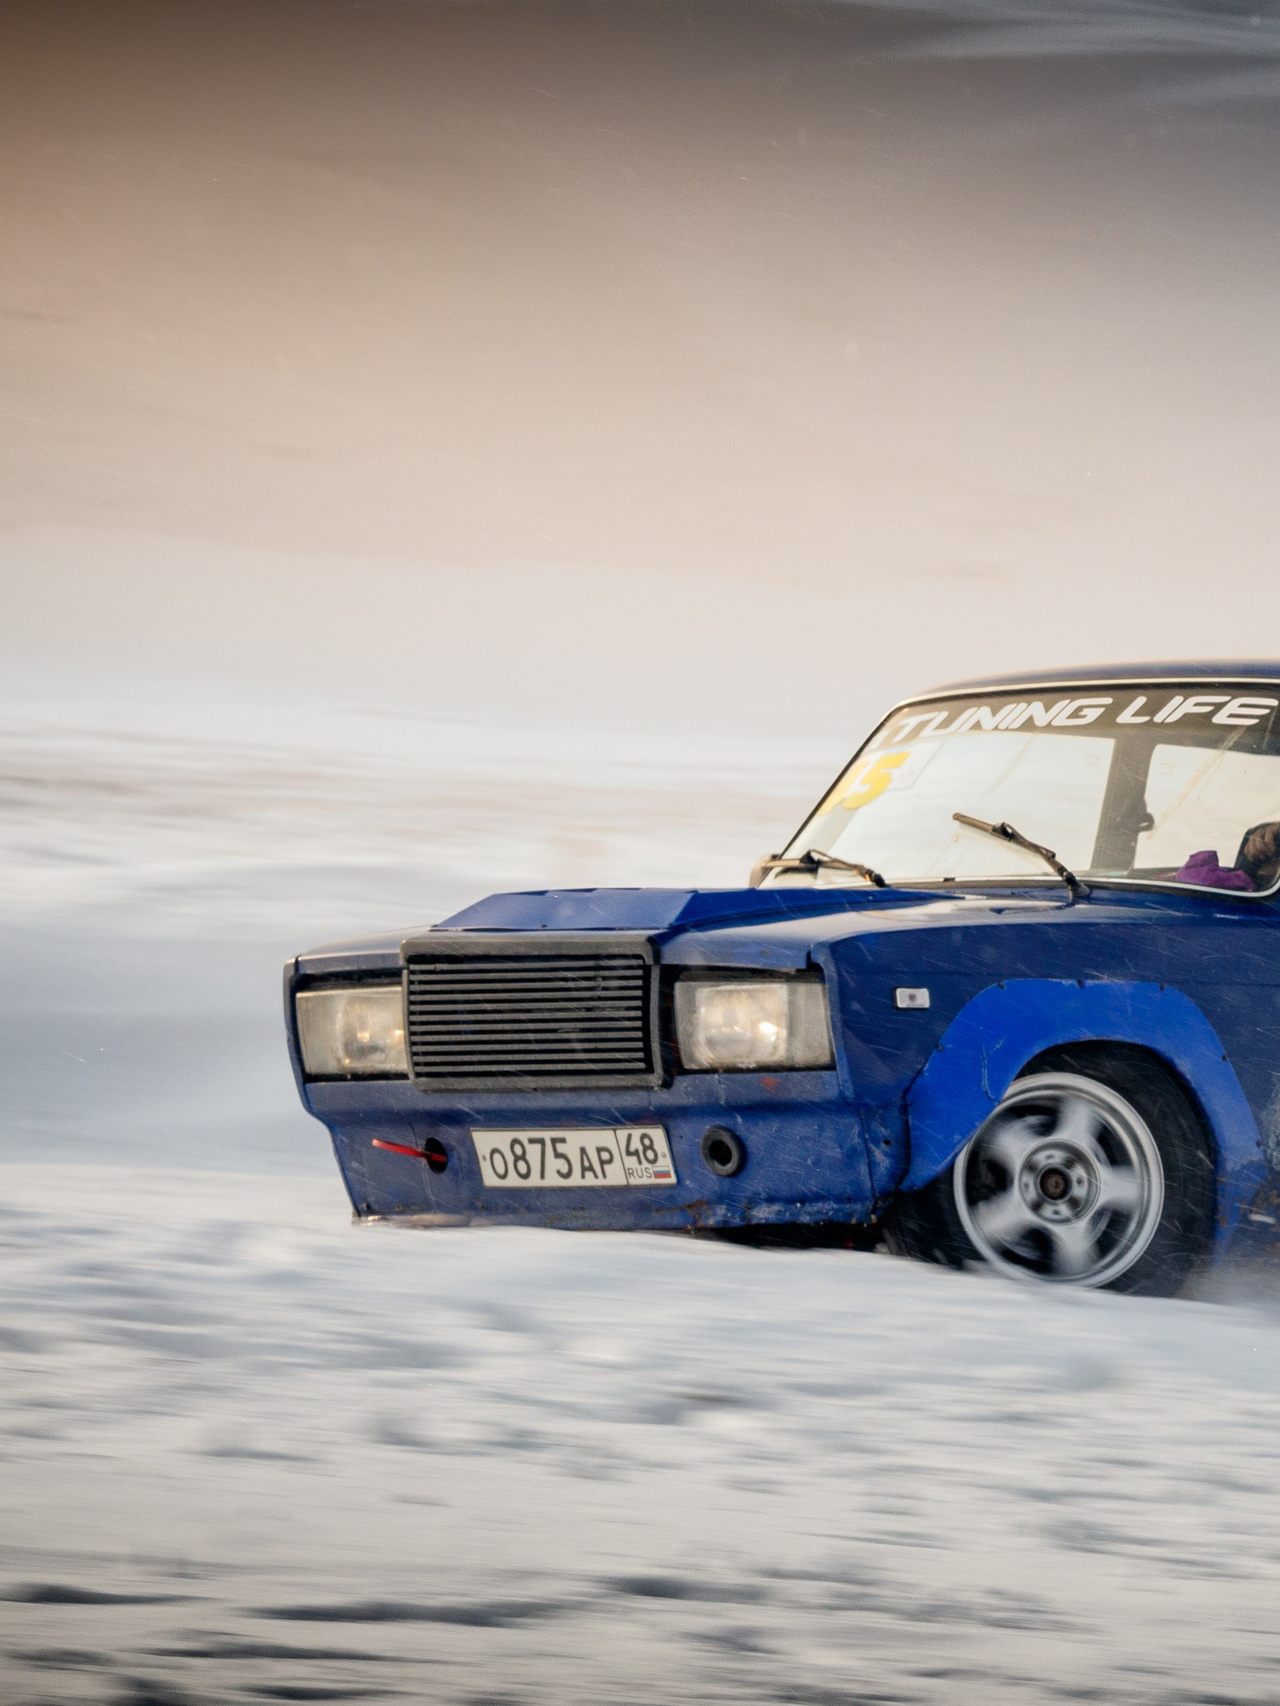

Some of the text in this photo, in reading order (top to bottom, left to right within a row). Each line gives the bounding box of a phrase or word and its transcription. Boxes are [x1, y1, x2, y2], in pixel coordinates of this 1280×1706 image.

[893, 696, 1278, 743] TUNING LIFE
[625, 1132, 659, 1165] 48
[627, 1166, 653, 1179] RUS
